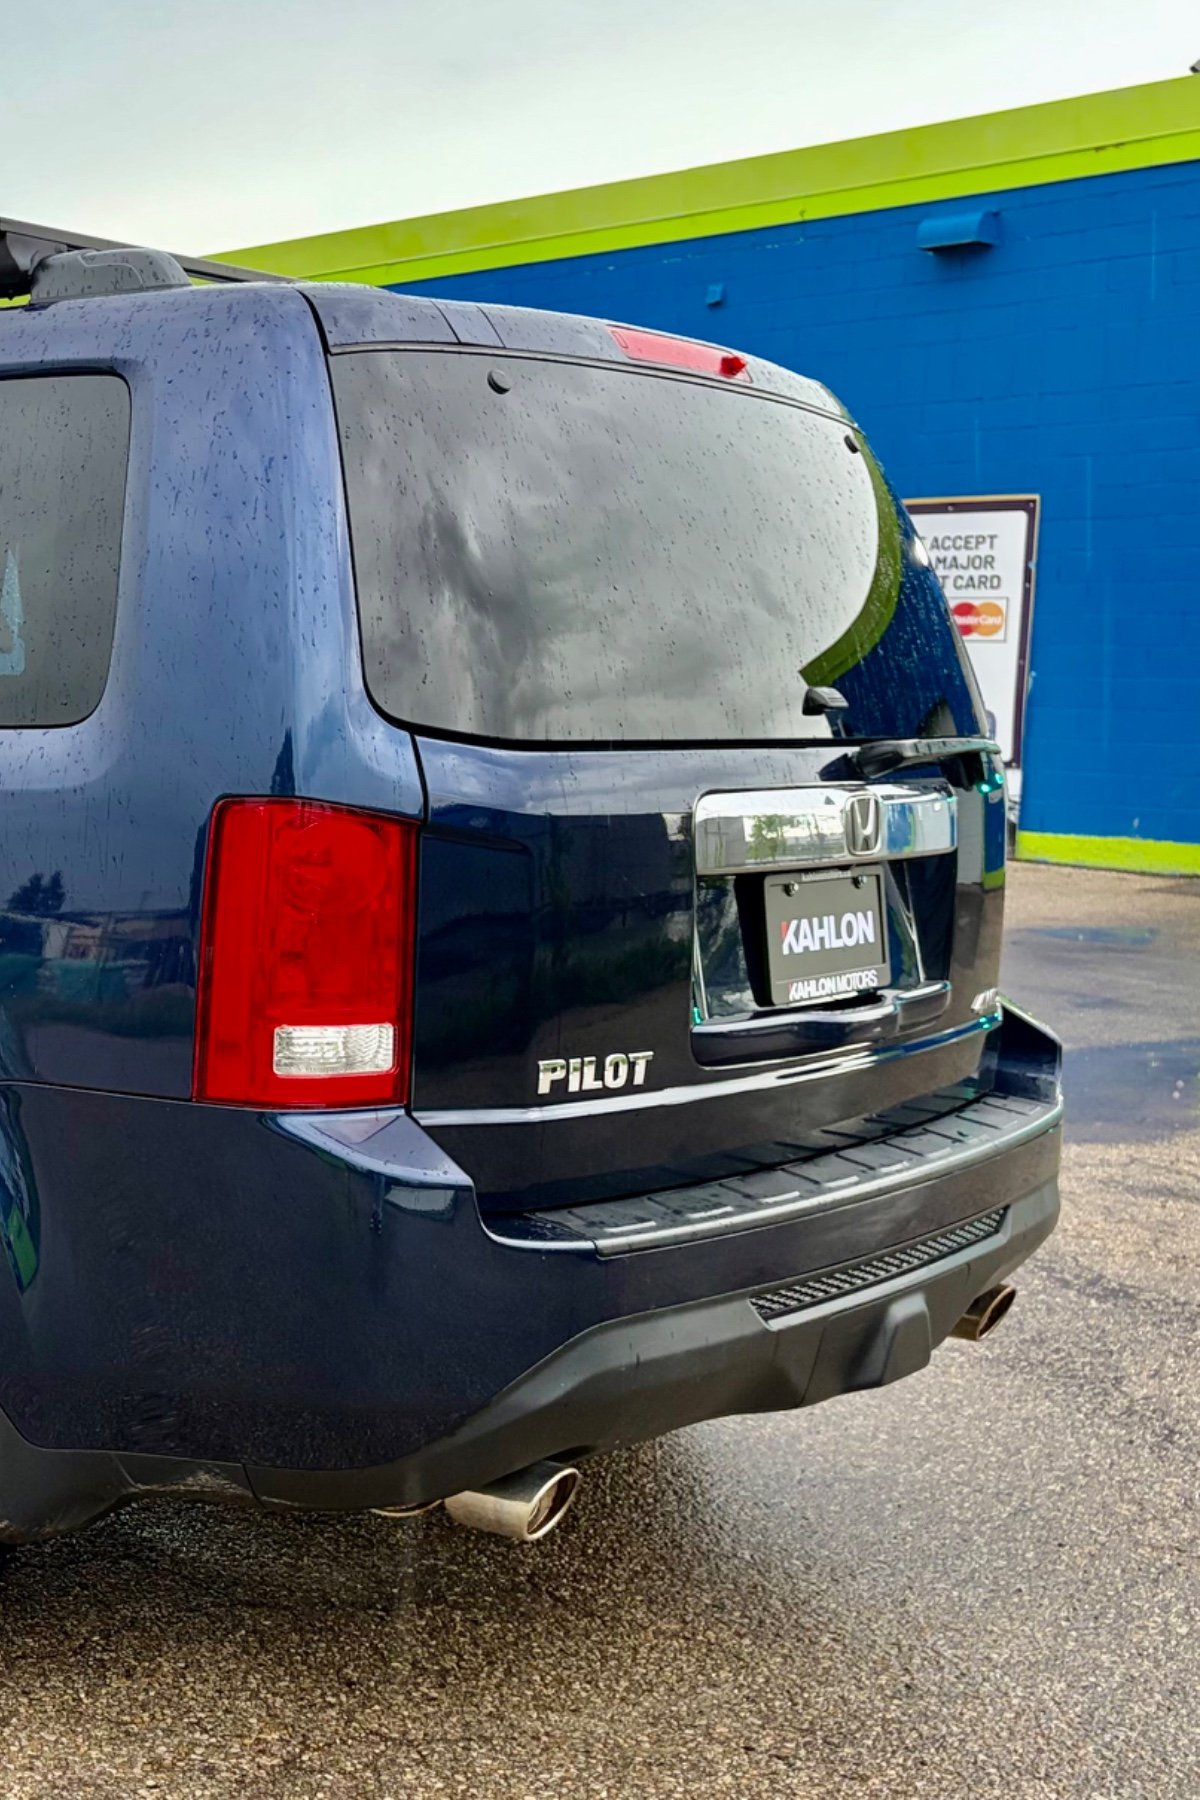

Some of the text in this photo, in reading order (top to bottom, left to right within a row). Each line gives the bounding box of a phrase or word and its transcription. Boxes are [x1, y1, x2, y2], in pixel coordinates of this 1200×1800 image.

[929, 534, 998, 551] ACCEPT
[934, 554, 995, 570] MAJOR
[953, 574, 1002, 590] CARD
[781, 910, 875, 955] KAHLON
[788, 969, 878, 1001] KAHLON MOTORS
[537, 1051, 654, 1095] PILOT
